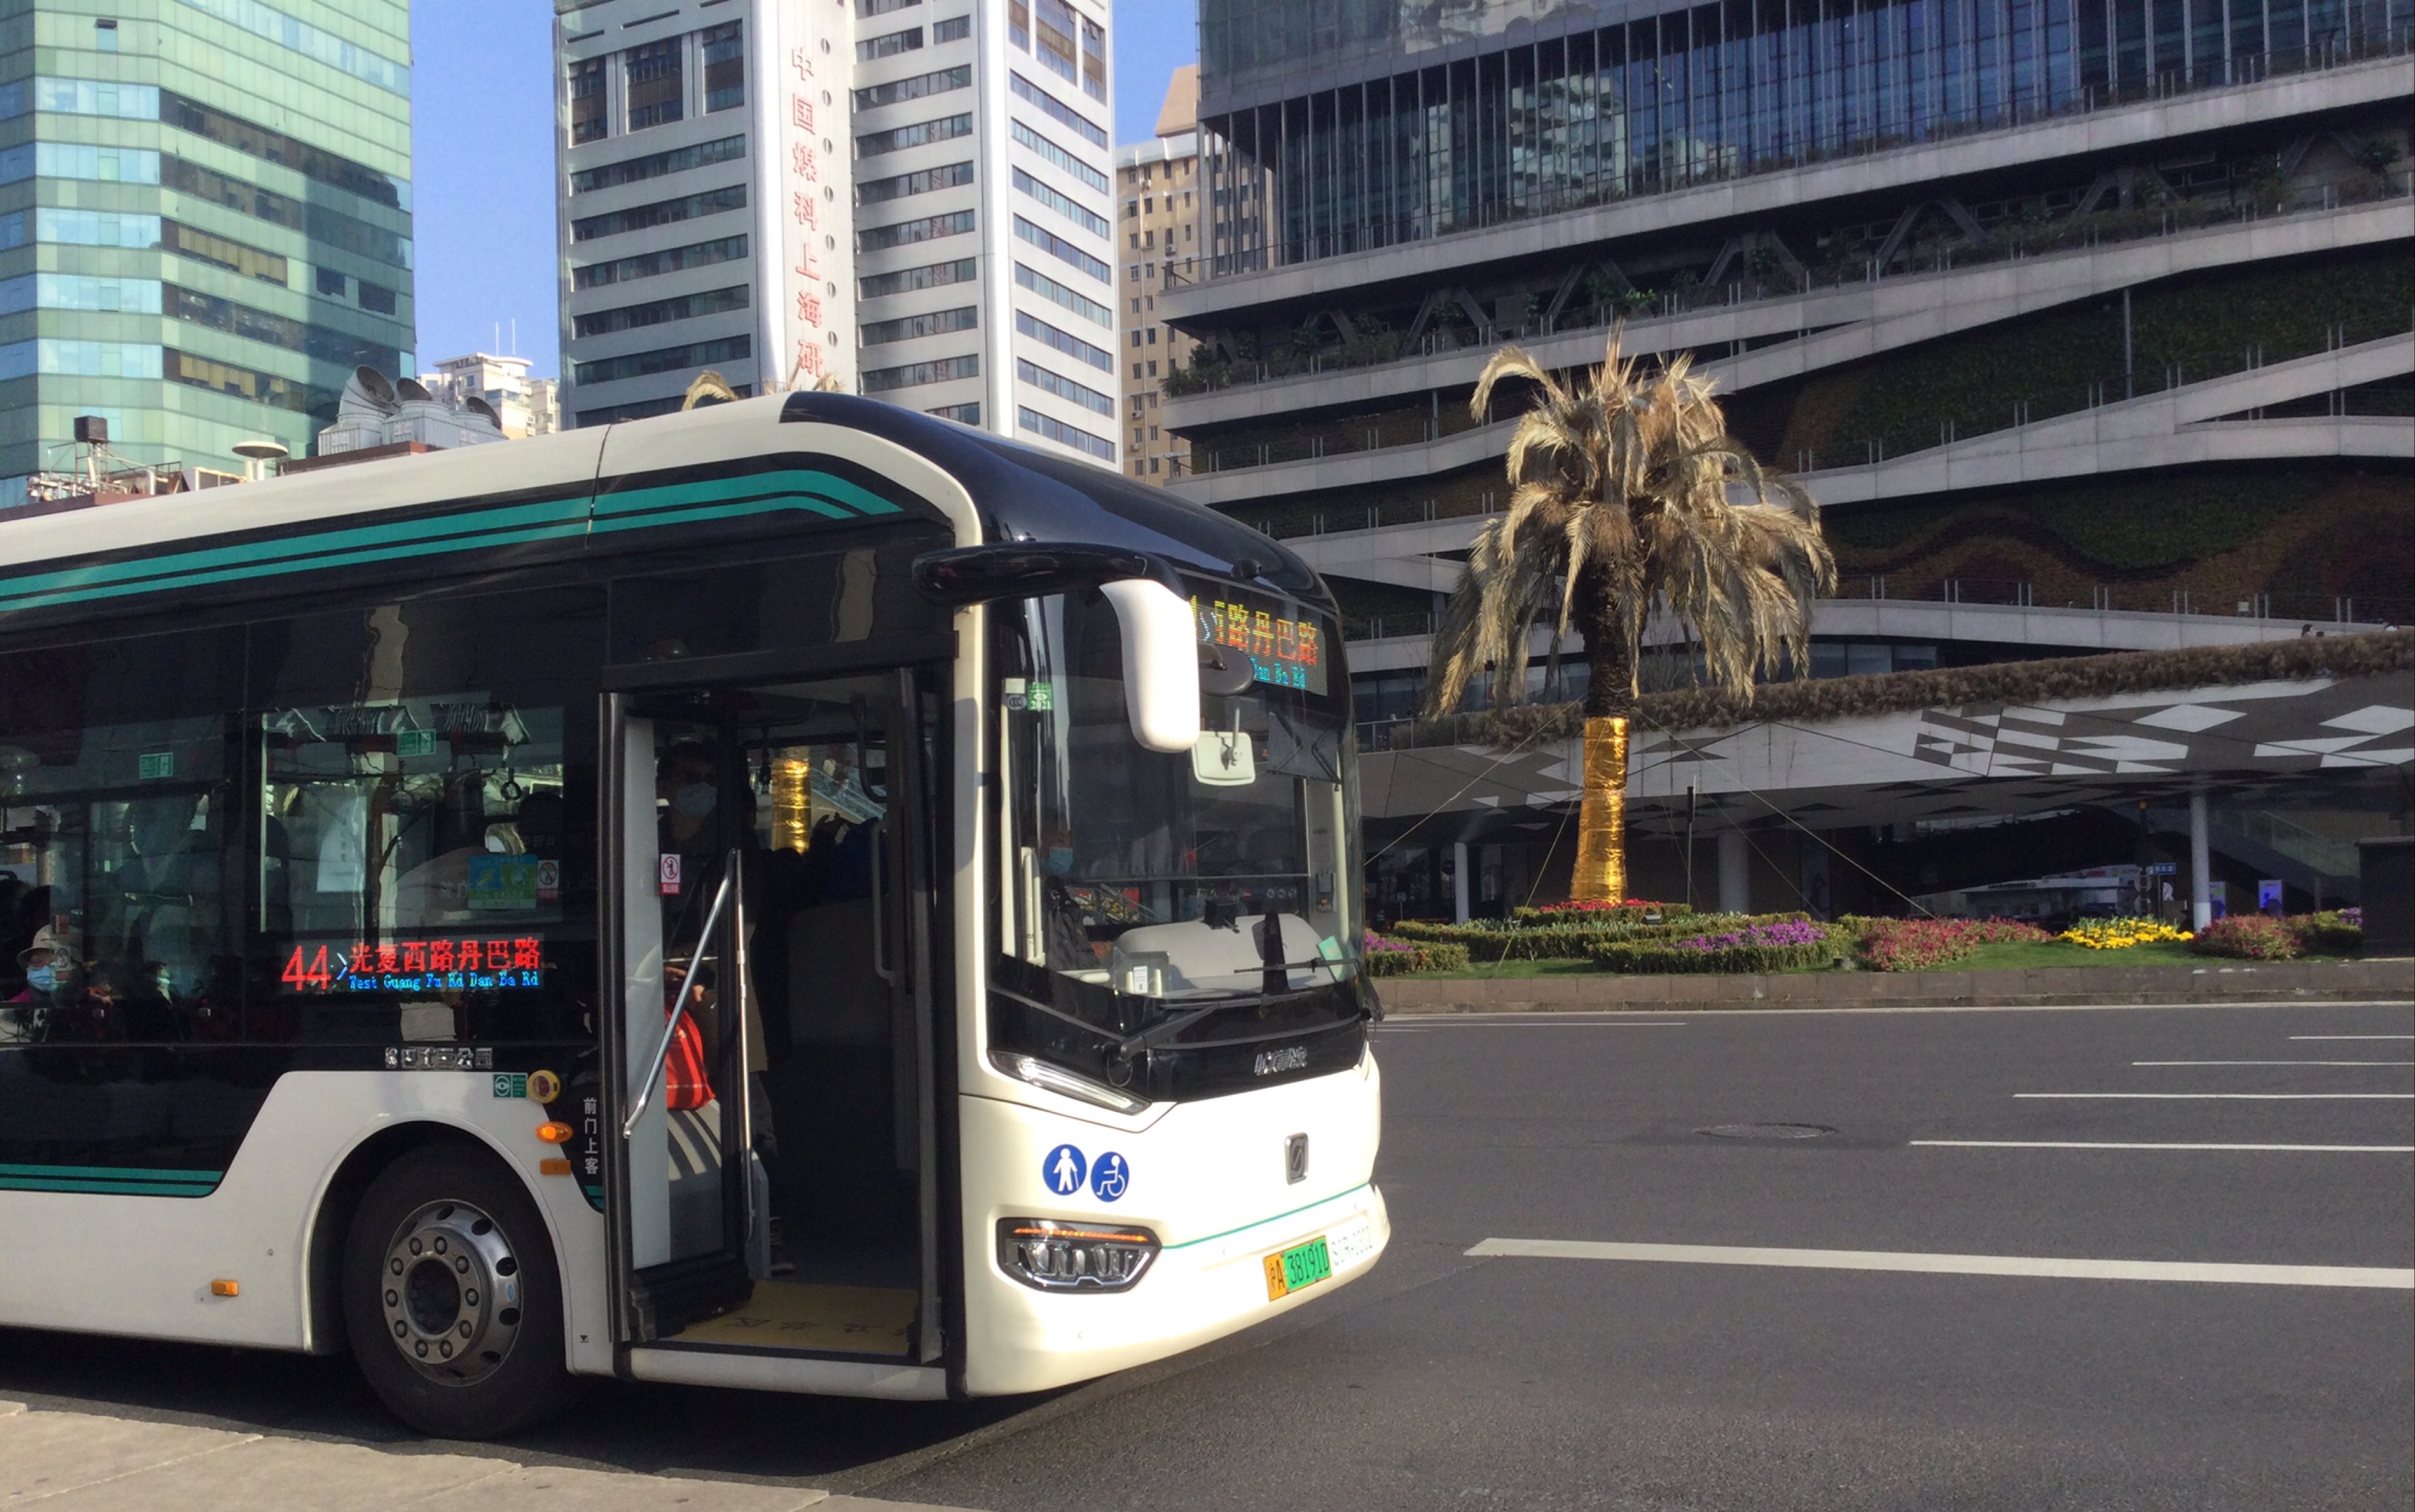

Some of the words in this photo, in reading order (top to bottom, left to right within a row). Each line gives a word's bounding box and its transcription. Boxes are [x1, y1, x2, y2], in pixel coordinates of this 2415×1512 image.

[282, 944, 332, 991] 44
[348, 936, 540, 974] 光复西路丹巴路
[384, 974, 421, 991] Guang
[426, 972, 442, 987] Fu
[447, 970, 464, 988] Rd
[470, 972, 493, 987] Dan
[499, 970, 515, 987] Ba
[521, 970, 538, 986] Rd
[583, 1097, 599, 1175] 前门上客
